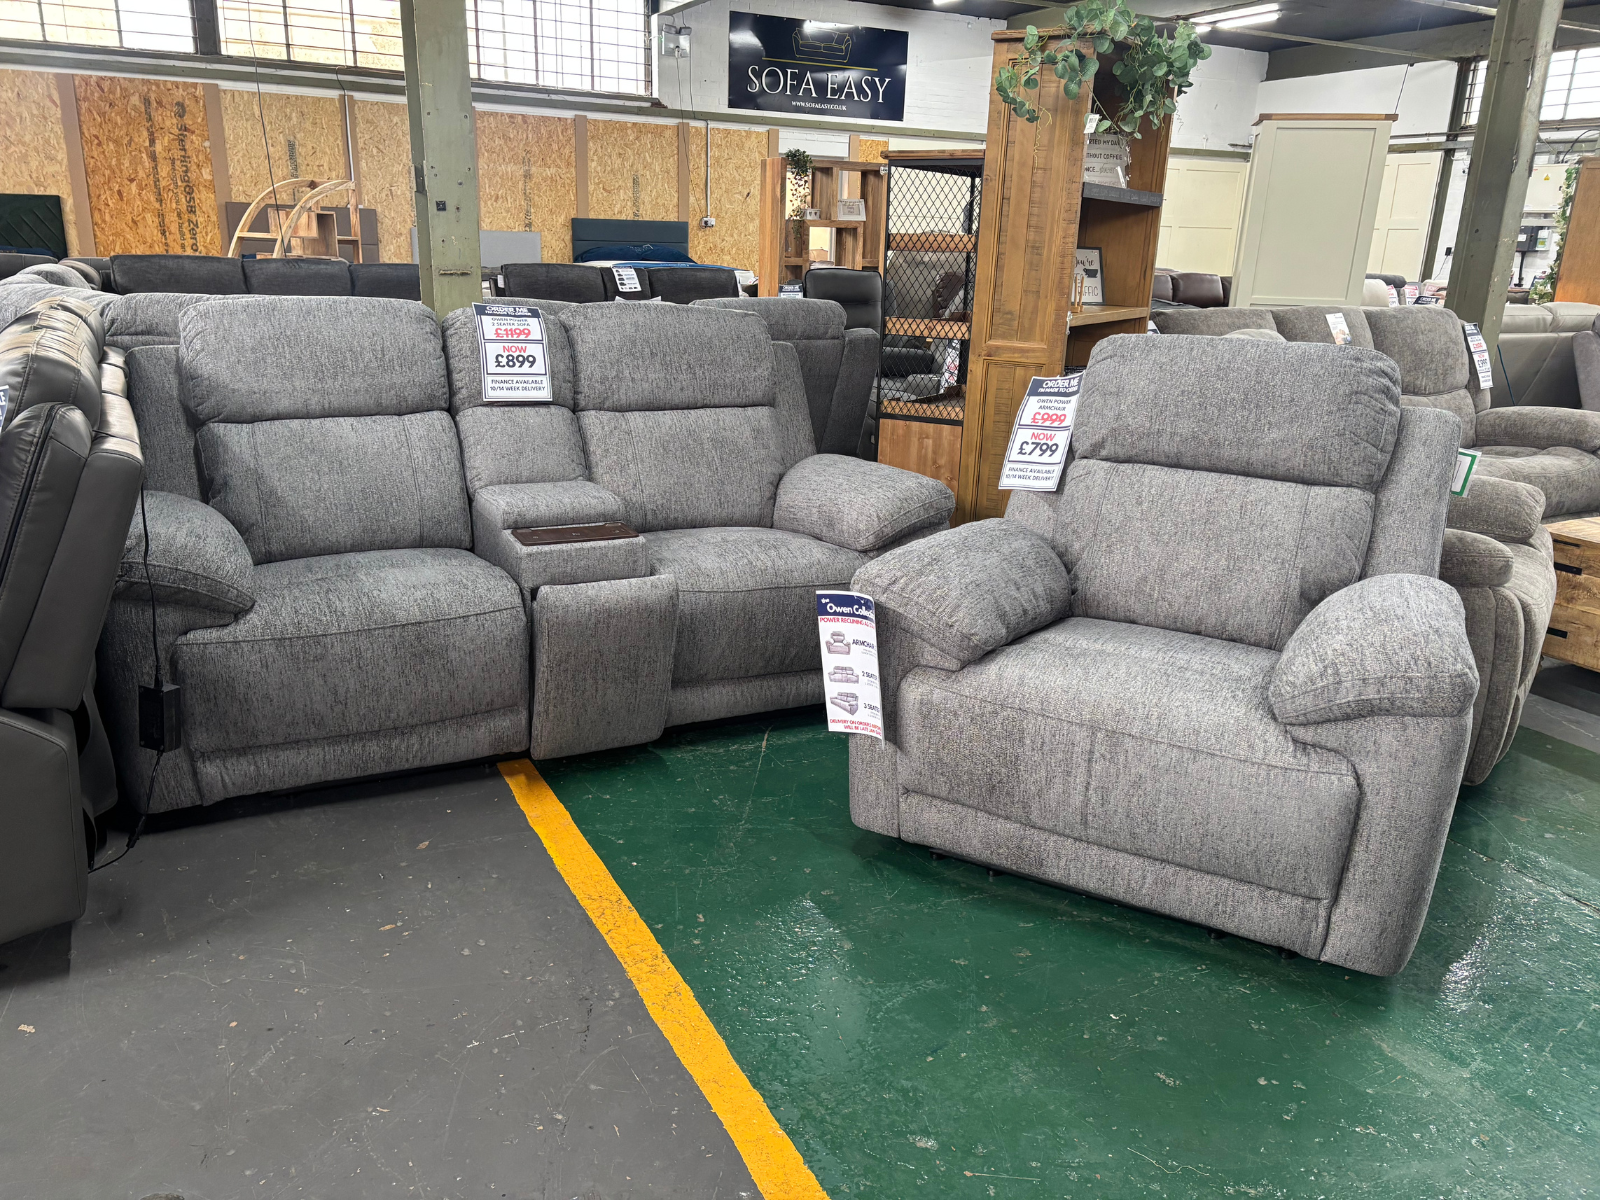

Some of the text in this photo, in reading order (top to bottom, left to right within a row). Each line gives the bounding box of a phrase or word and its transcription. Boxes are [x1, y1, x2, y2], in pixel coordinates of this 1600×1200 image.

[747, 65, 892, 102] SOFA EASY
[791, 100, 847, 110] WWW.SOFAEASY.CO.UK
[188, 218, 200, 252] Zero
[494, 328, 531, 338] £1199
[495, 354, 536, 368] £899
[1070, 377, 1080, 386] ME
[1031, 412, 1066, 425] £999
[1030, 432, 1056, 441] NOW
[1017, 441, 1059, 457] £799
[827, 603, 853, 614] Owen
